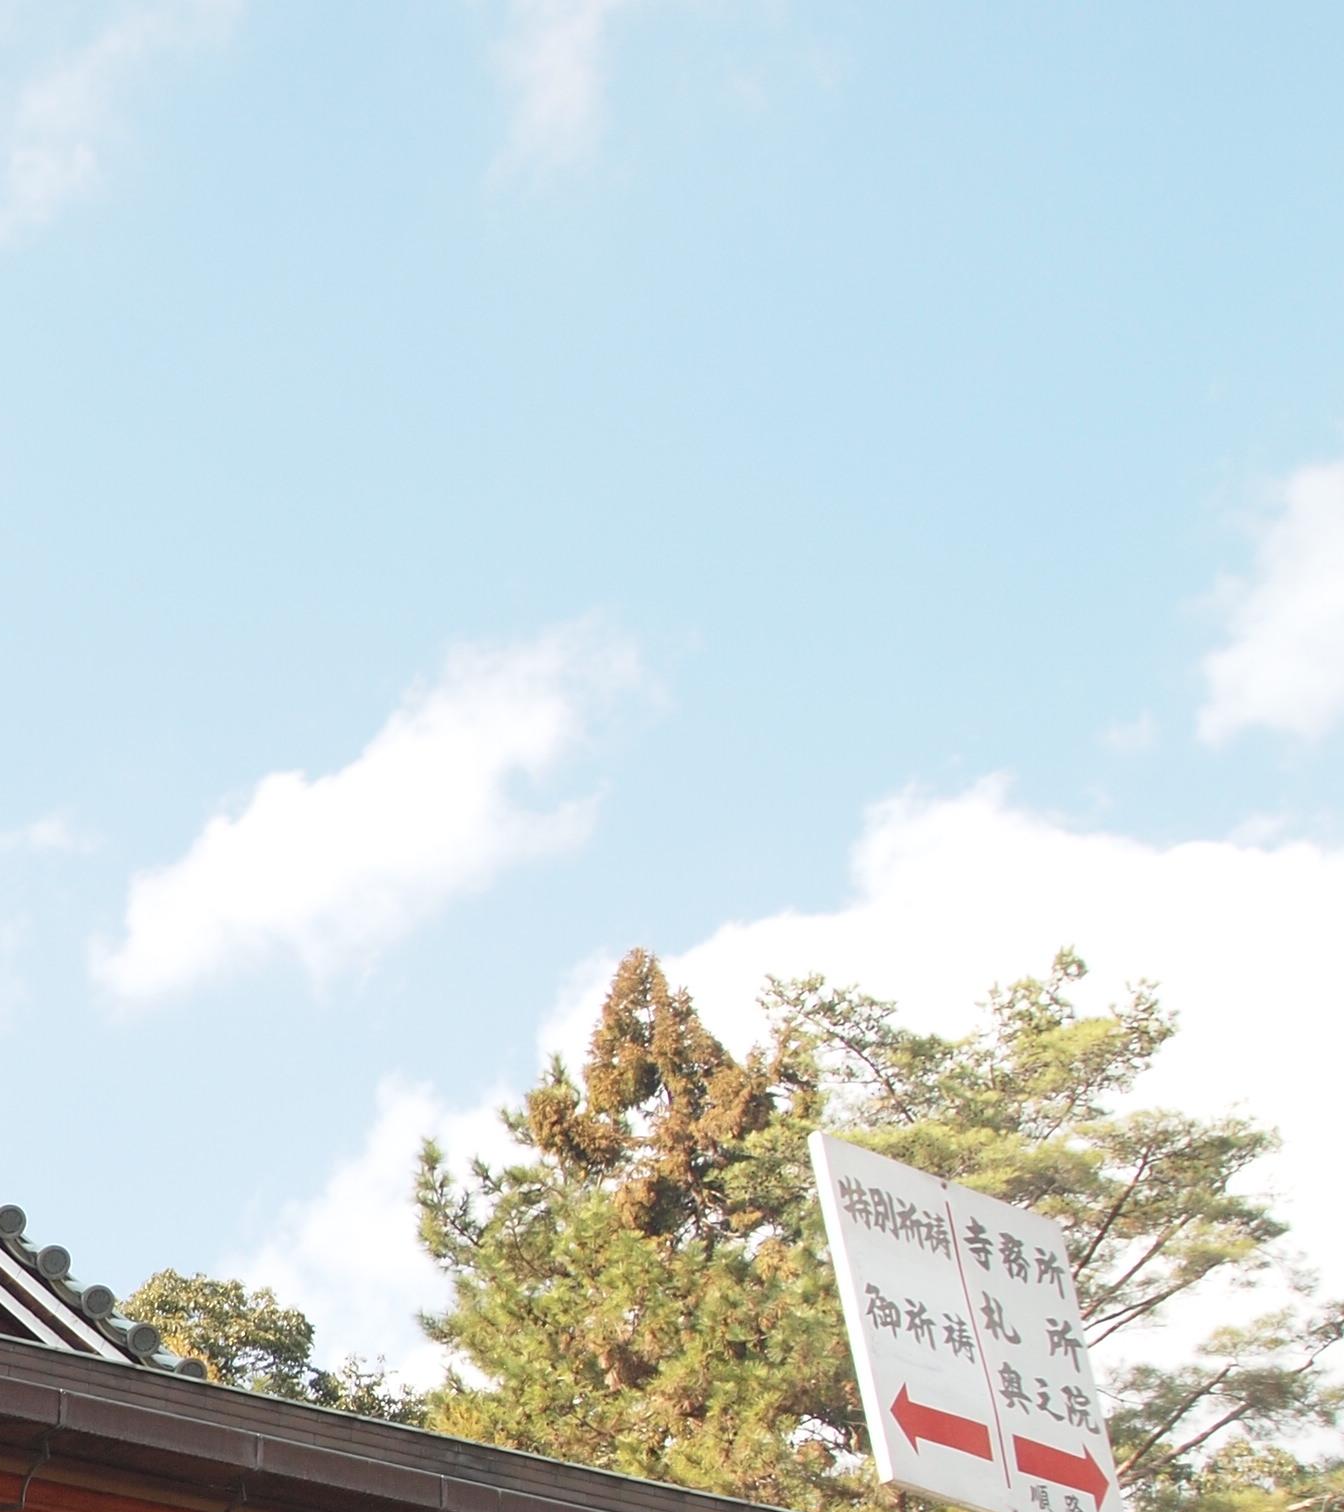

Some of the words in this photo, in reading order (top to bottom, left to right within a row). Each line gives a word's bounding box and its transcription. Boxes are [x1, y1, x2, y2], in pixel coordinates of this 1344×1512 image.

[837, 1174, 952, 1261] 特別祈祷
[963, 1216, 1066, 1300] 寺務所
[864, 1282, 976, 1364] 御祈祷
[998, 1361, 1101, 1435] 奥之院
